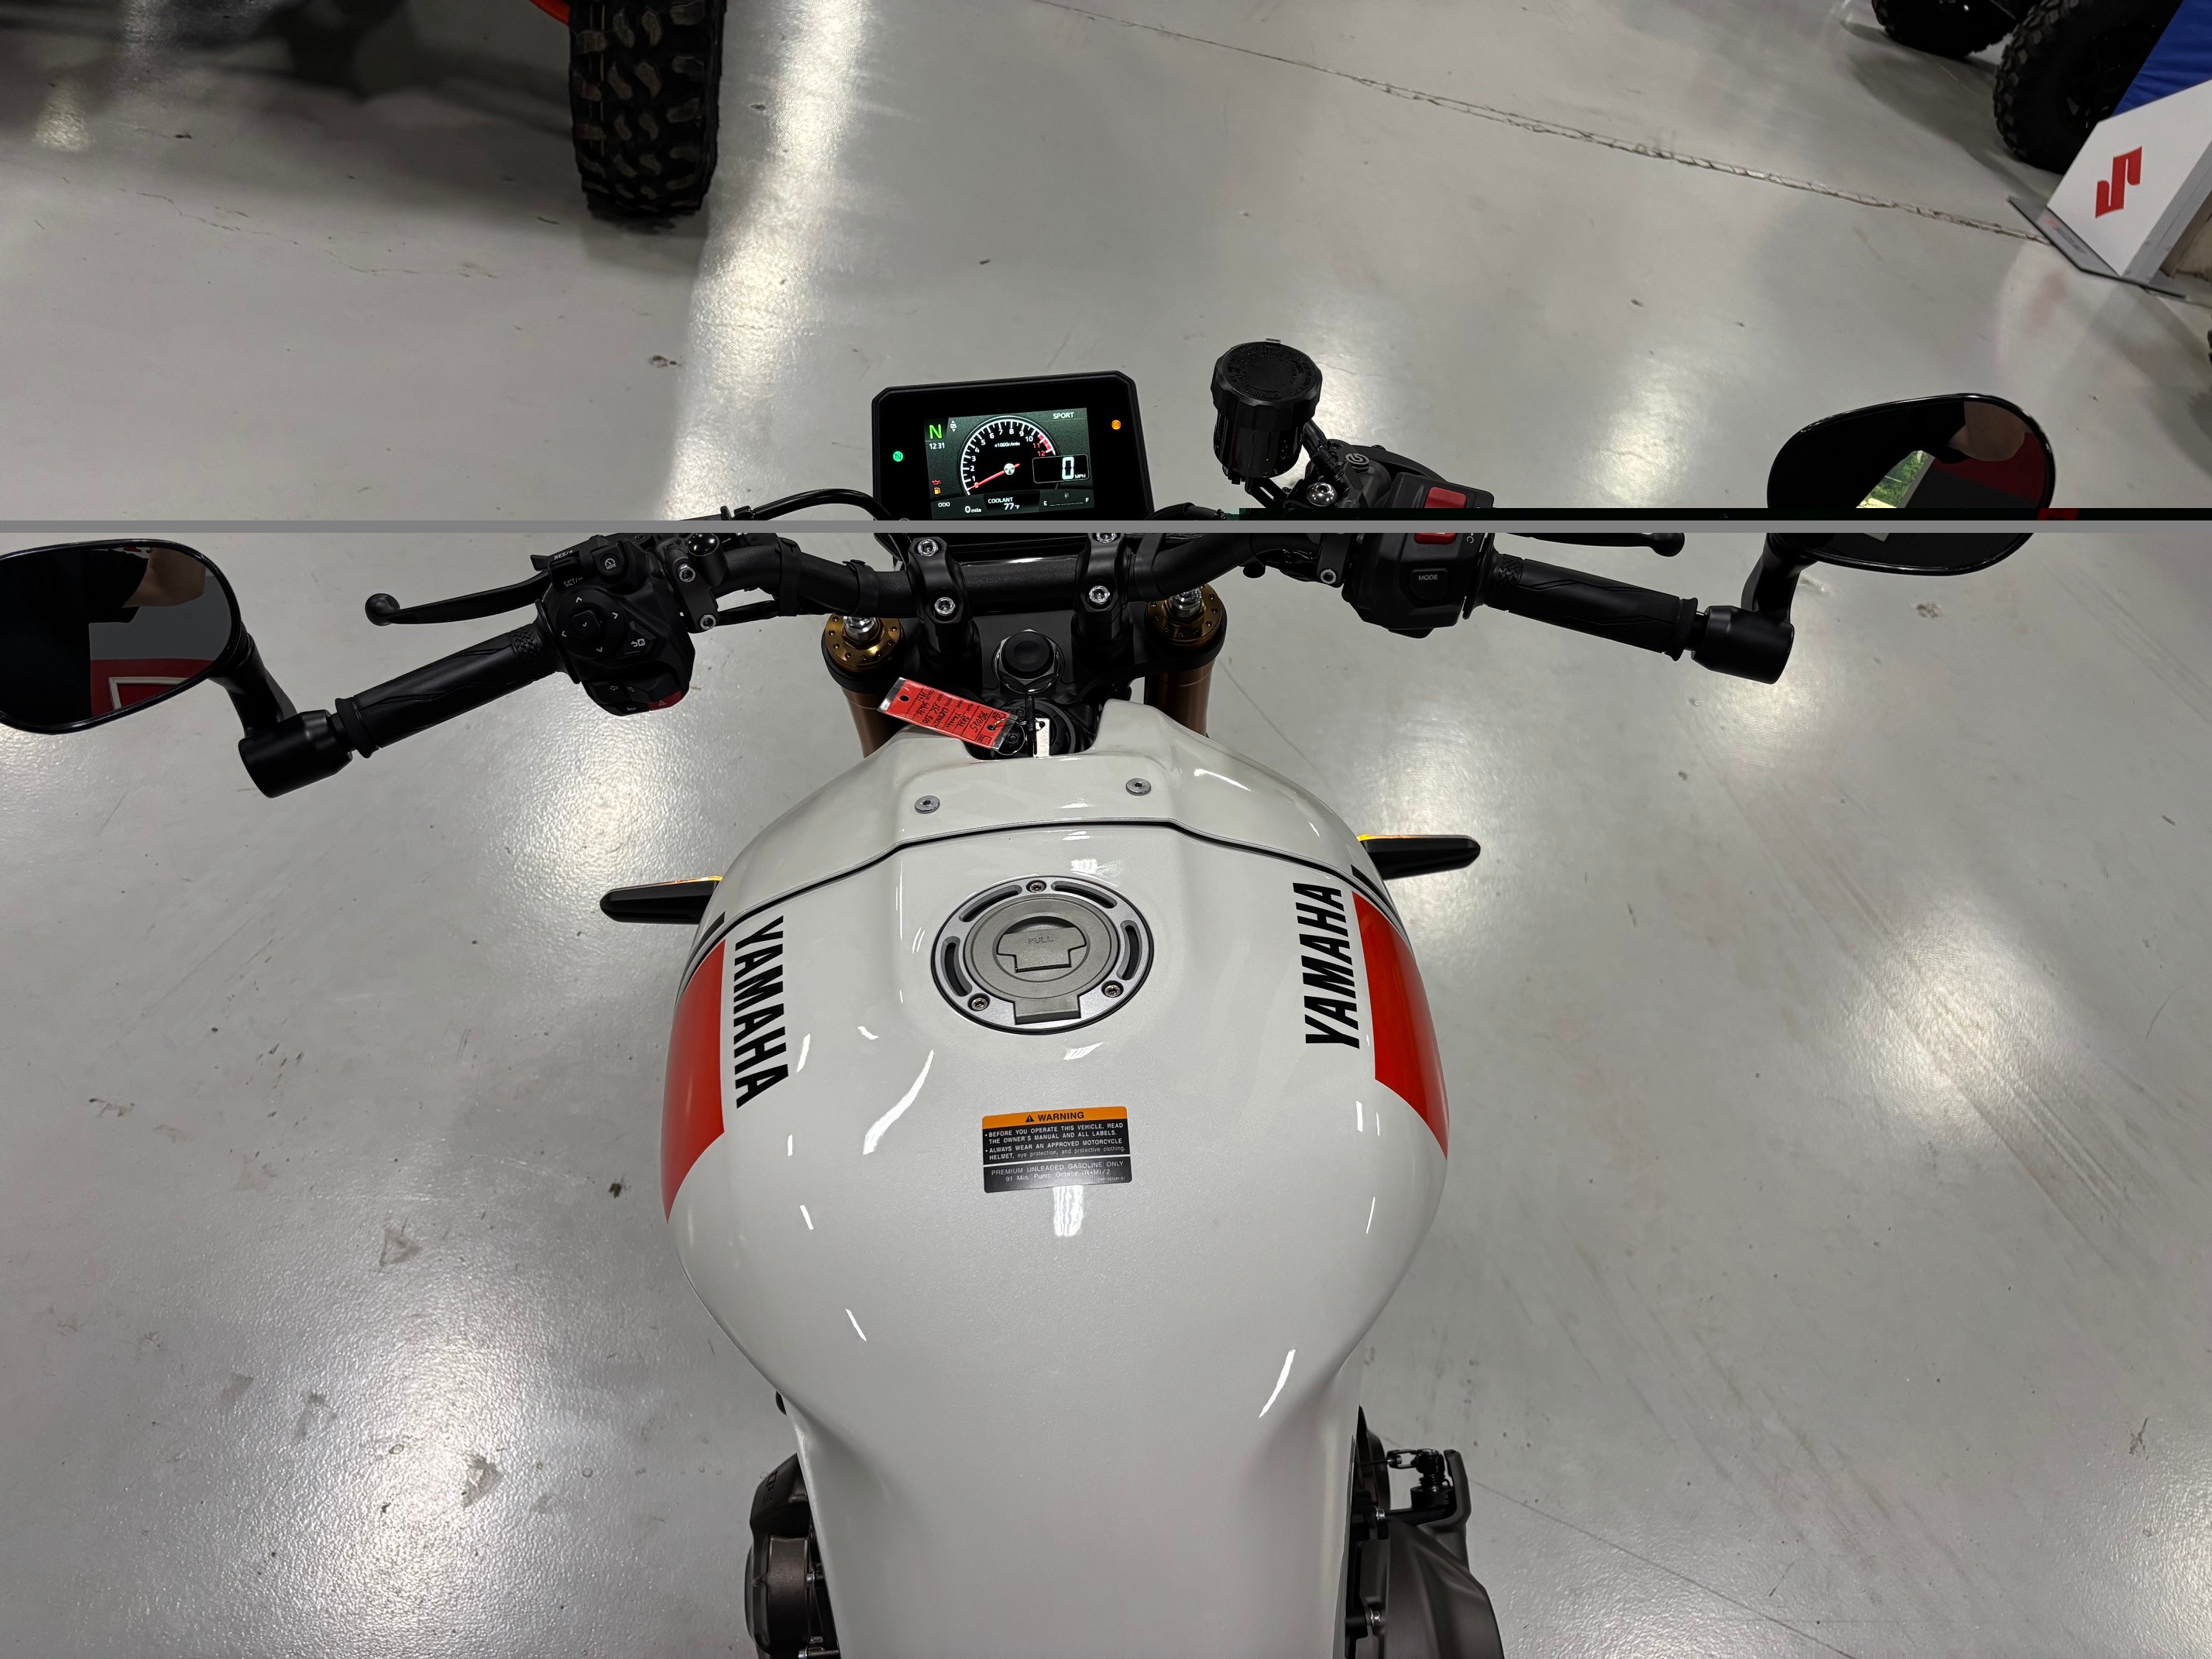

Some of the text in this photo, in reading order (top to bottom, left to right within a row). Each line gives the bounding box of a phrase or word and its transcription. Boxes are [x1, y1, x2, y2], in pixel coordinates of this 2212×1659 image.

[929, 424, 943, 439] N
[1062, 456, 1074, 480] 0
[554, 550, 573, 560] RES/+
[1293, 882, 1360, 1049] YAMAHA
[733, 915, 788, 1109] YAMAHA
[1038, 1111, 1084, 1122] WARNING
[991, 1167, 1023, 1176] PREMIUM
[1026, 1164, 1064, 1173] UNLEADED
